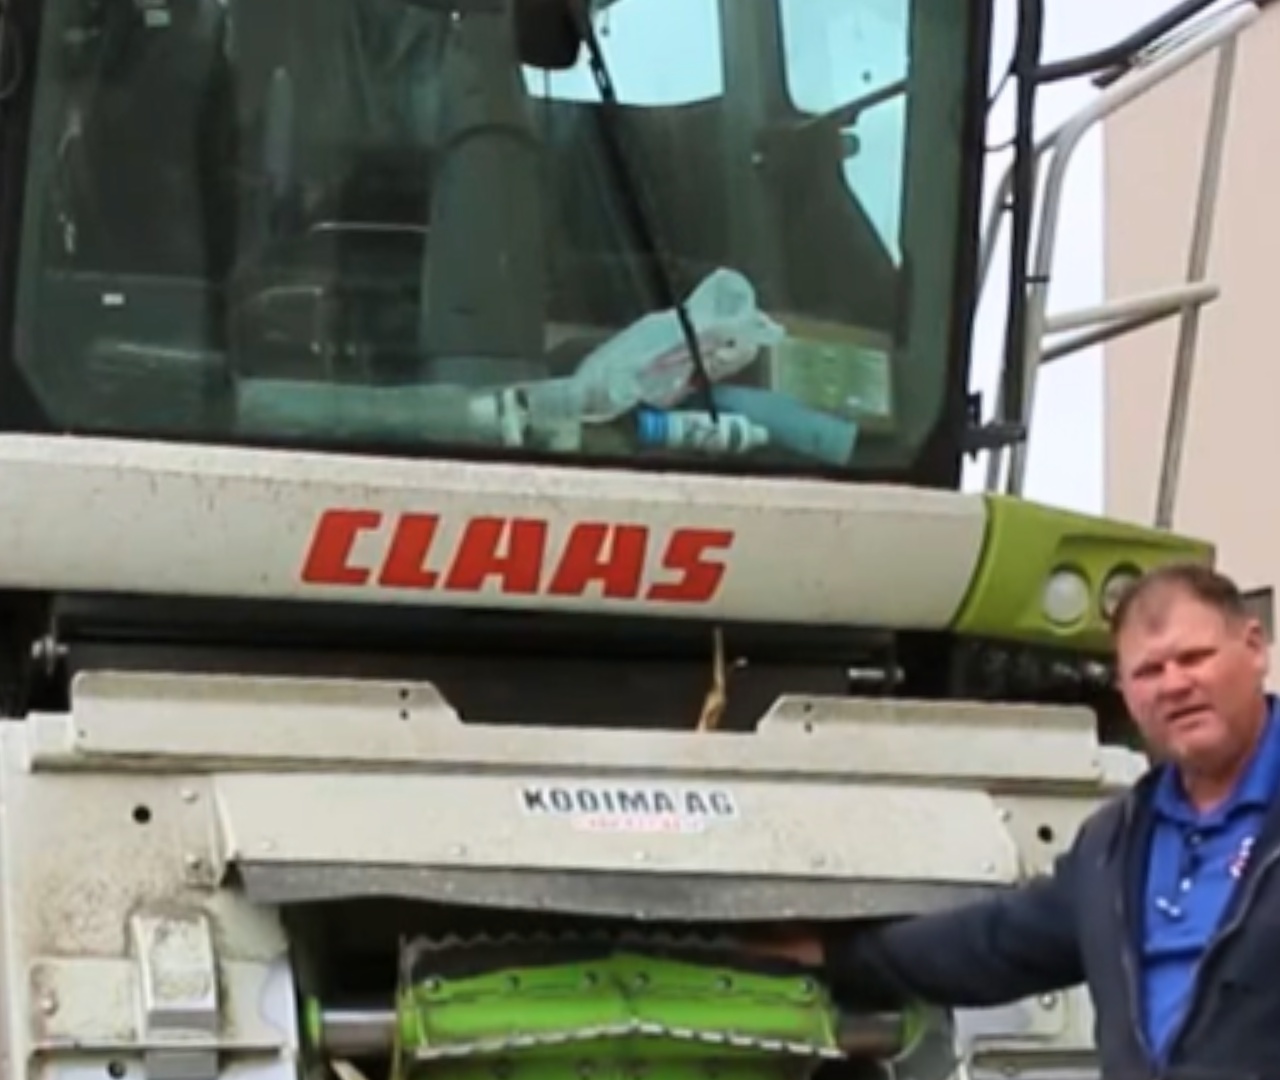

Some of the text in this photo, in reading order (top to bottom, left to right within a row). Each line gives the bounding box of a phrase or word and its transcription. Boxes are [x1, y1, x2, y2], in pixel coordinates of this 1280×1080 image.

[302, 508, 734, 603] CLAAS
[523, 787, 734, 816] KOOIMA AG
